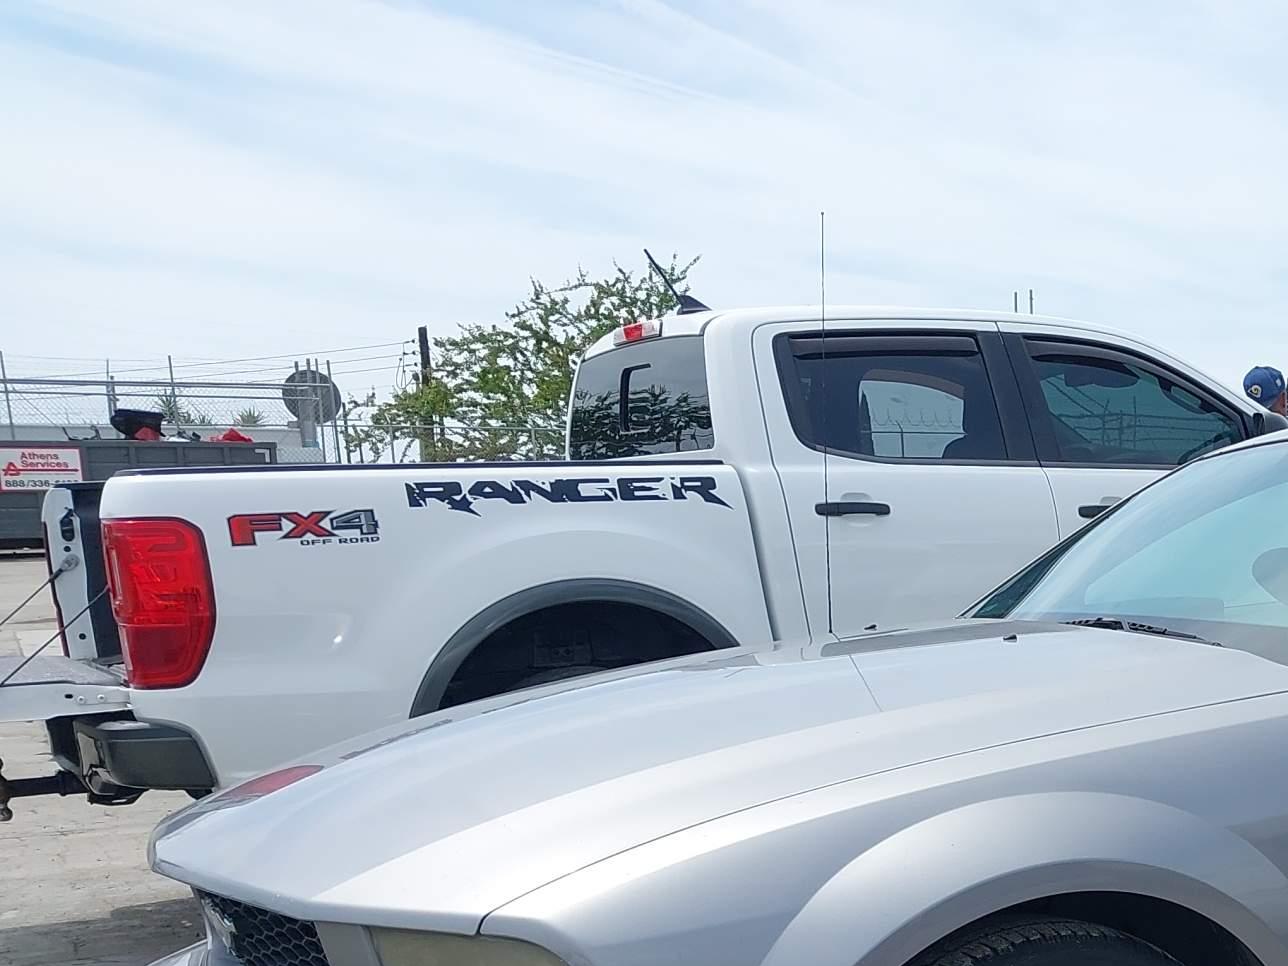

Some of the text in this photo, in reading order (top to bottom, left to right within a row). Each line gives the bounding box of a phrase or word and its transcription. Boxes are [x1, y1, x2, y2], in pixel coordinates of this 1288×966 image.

[20, 451, 59, 460] Athens
[20, 460, 69, 468] Services
[404, 475, 735, 517] RANGER
[227, 508, 380, 547] FX4
[299, 535, 380, 547] OFF ROAD
